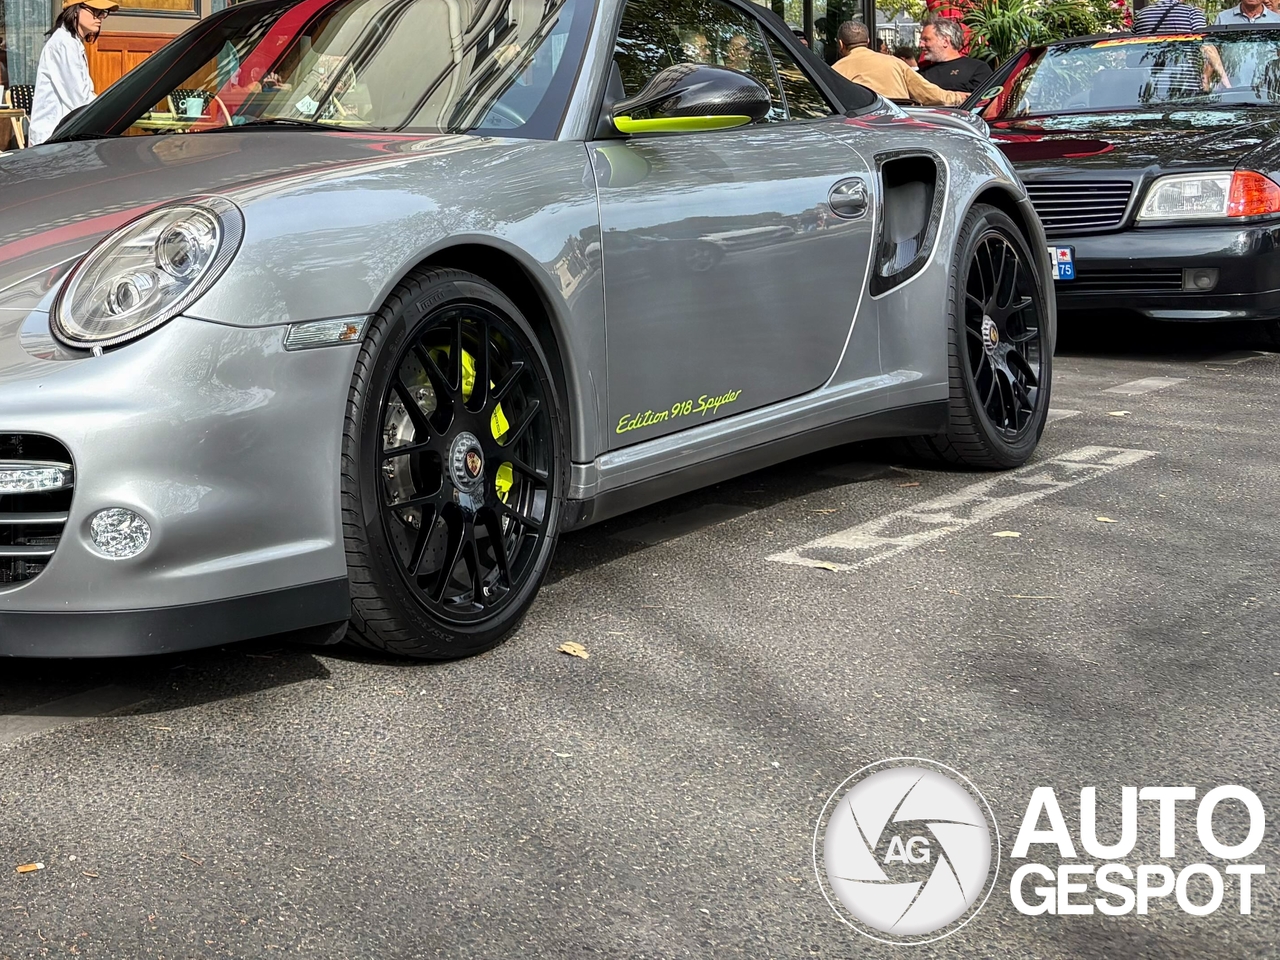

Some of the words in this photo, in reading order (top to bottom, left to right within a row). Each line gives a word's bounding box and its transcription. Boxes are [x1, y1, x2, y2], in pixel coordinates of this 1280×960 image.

[1058, 264, 1072, 276] 75
[616, 409, 669, 434] Edition
[671, 399, 694, 419] 918
[692, 389, 742, 417] Spyder
